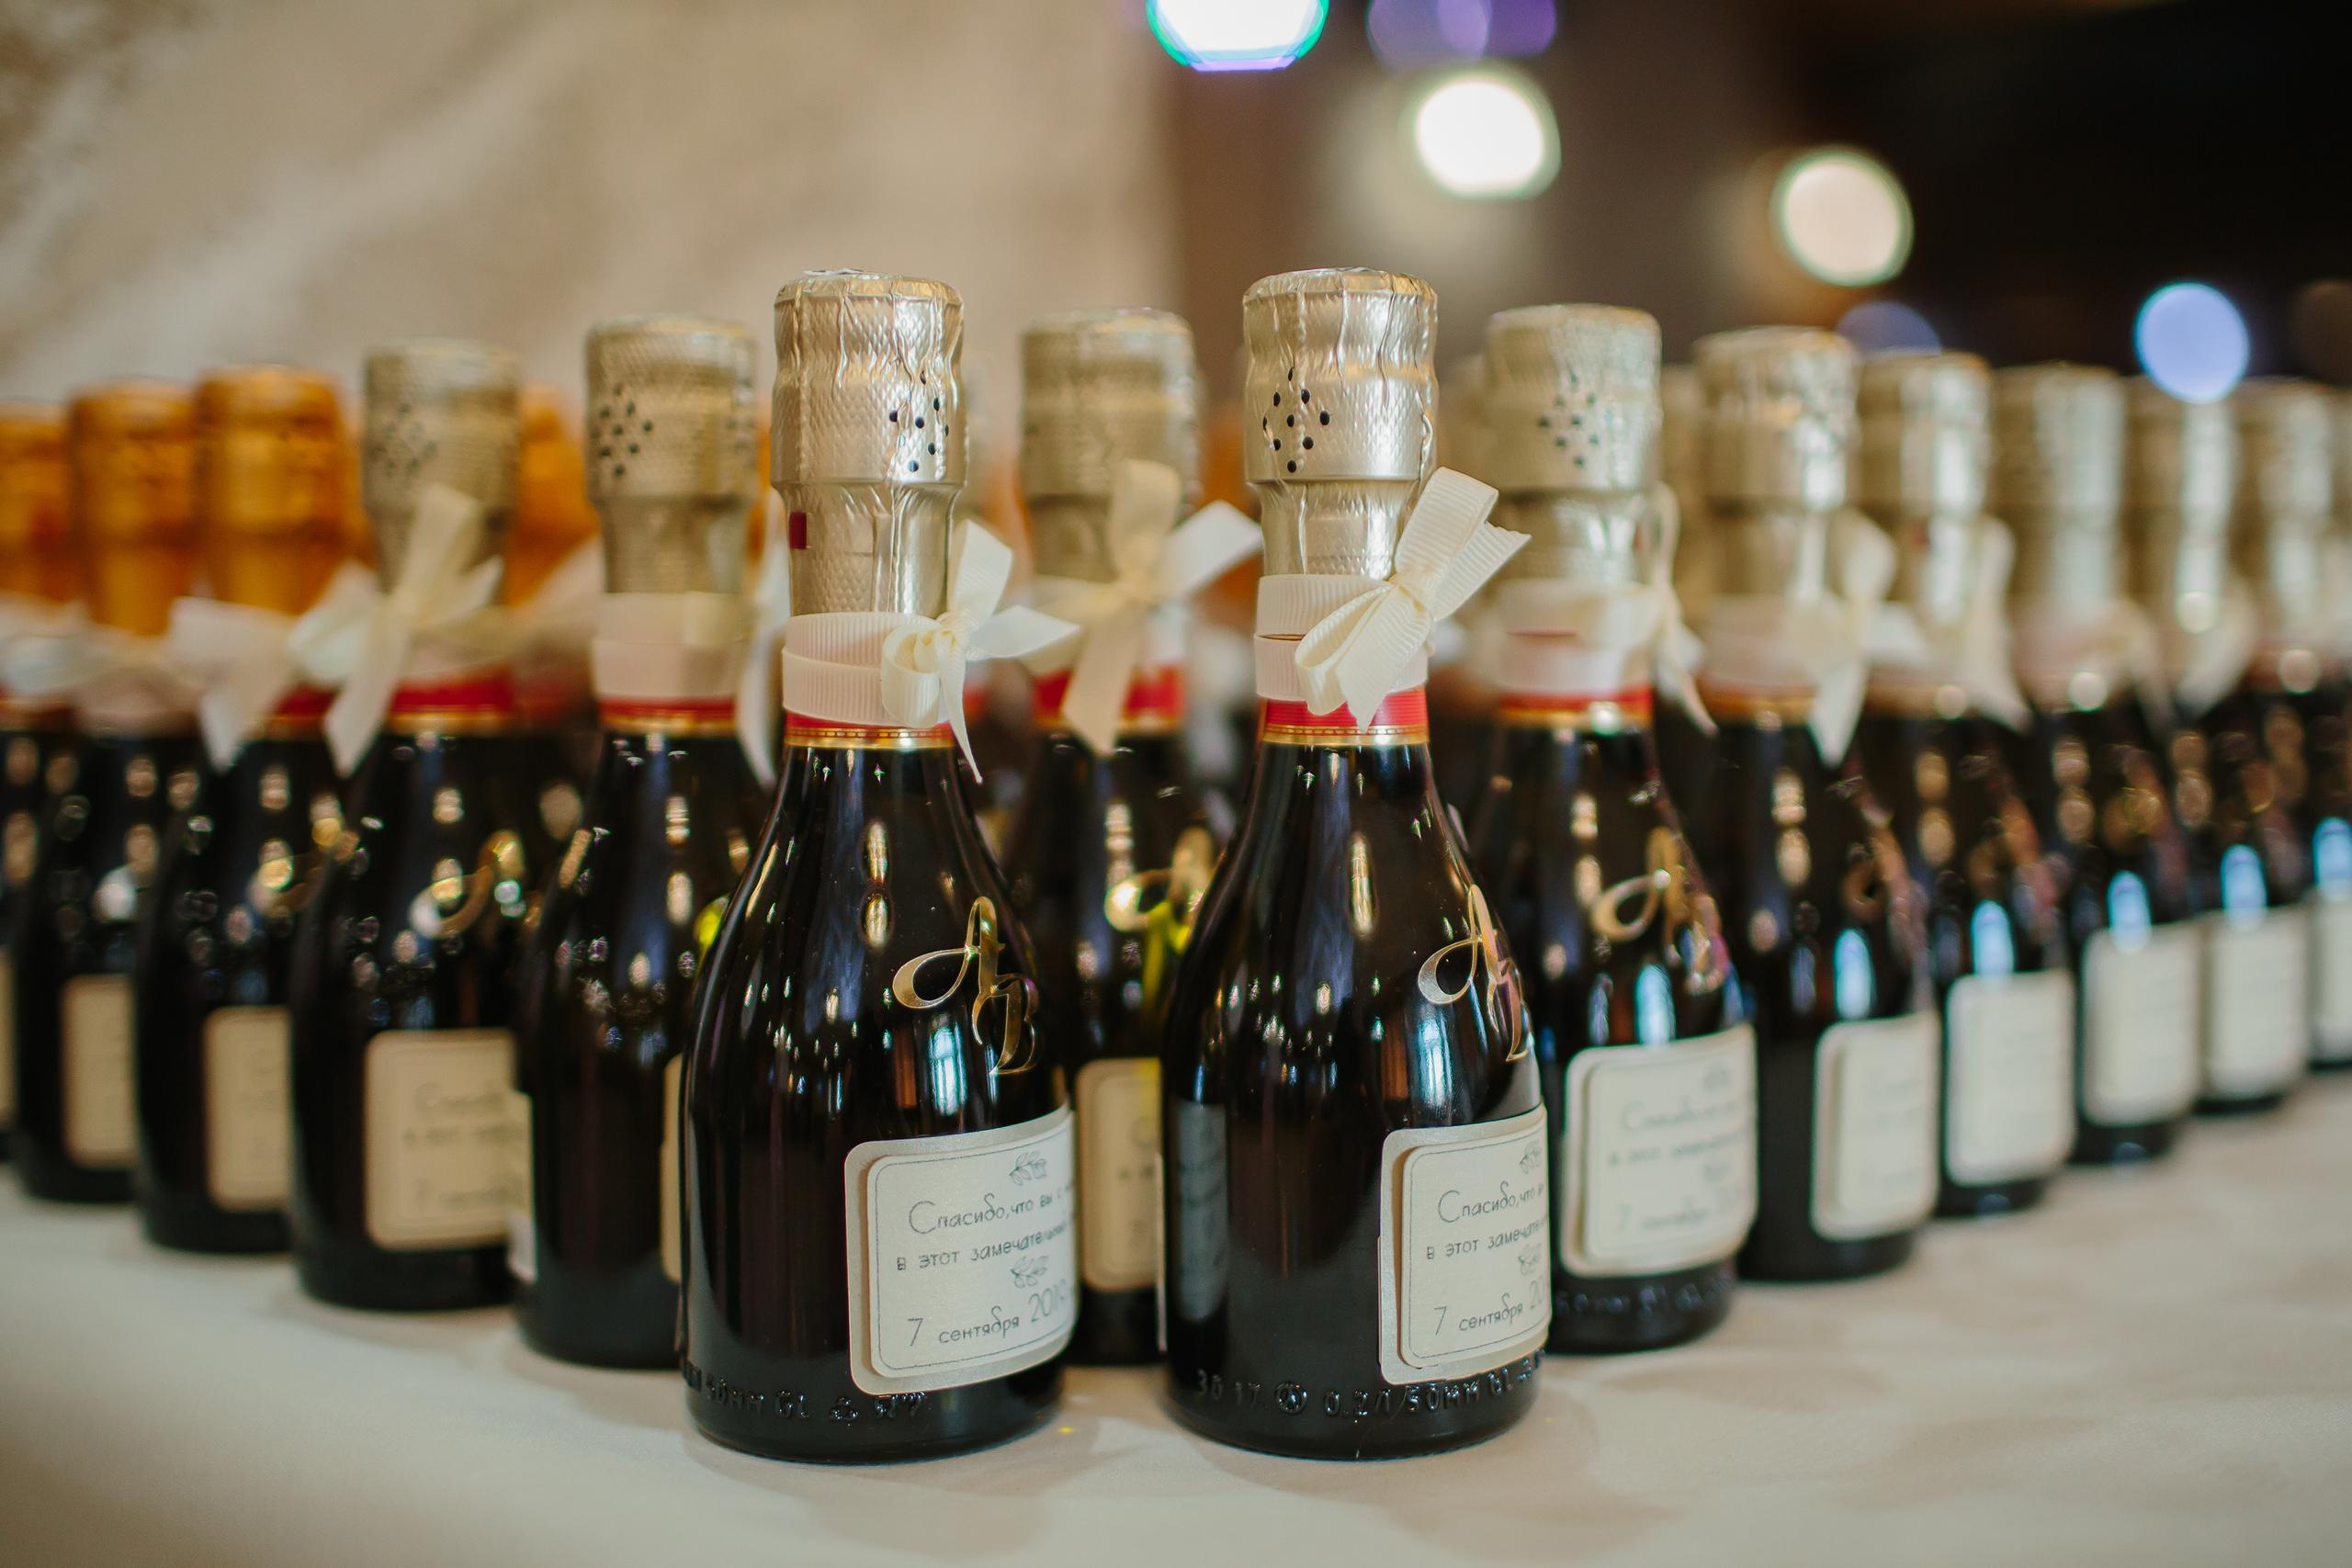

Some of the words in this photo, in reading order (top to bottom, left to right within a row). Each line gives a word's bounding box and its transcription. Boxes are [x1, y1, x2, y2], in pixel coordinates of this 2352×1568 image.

[897, 1257, 907, 1270] в
[919, 1250, 960, 1269] этот
[1426, 1246, 1435, 1259] в
[1445, 1238, 1478, 1258] этот
[908, 1317, 923, 1347] 7
[938, 1305, 1020, 1343] сентября
[1434, 1305, 1447, 1335] 7
[1458, 1292, 1523, 1331] сентября
